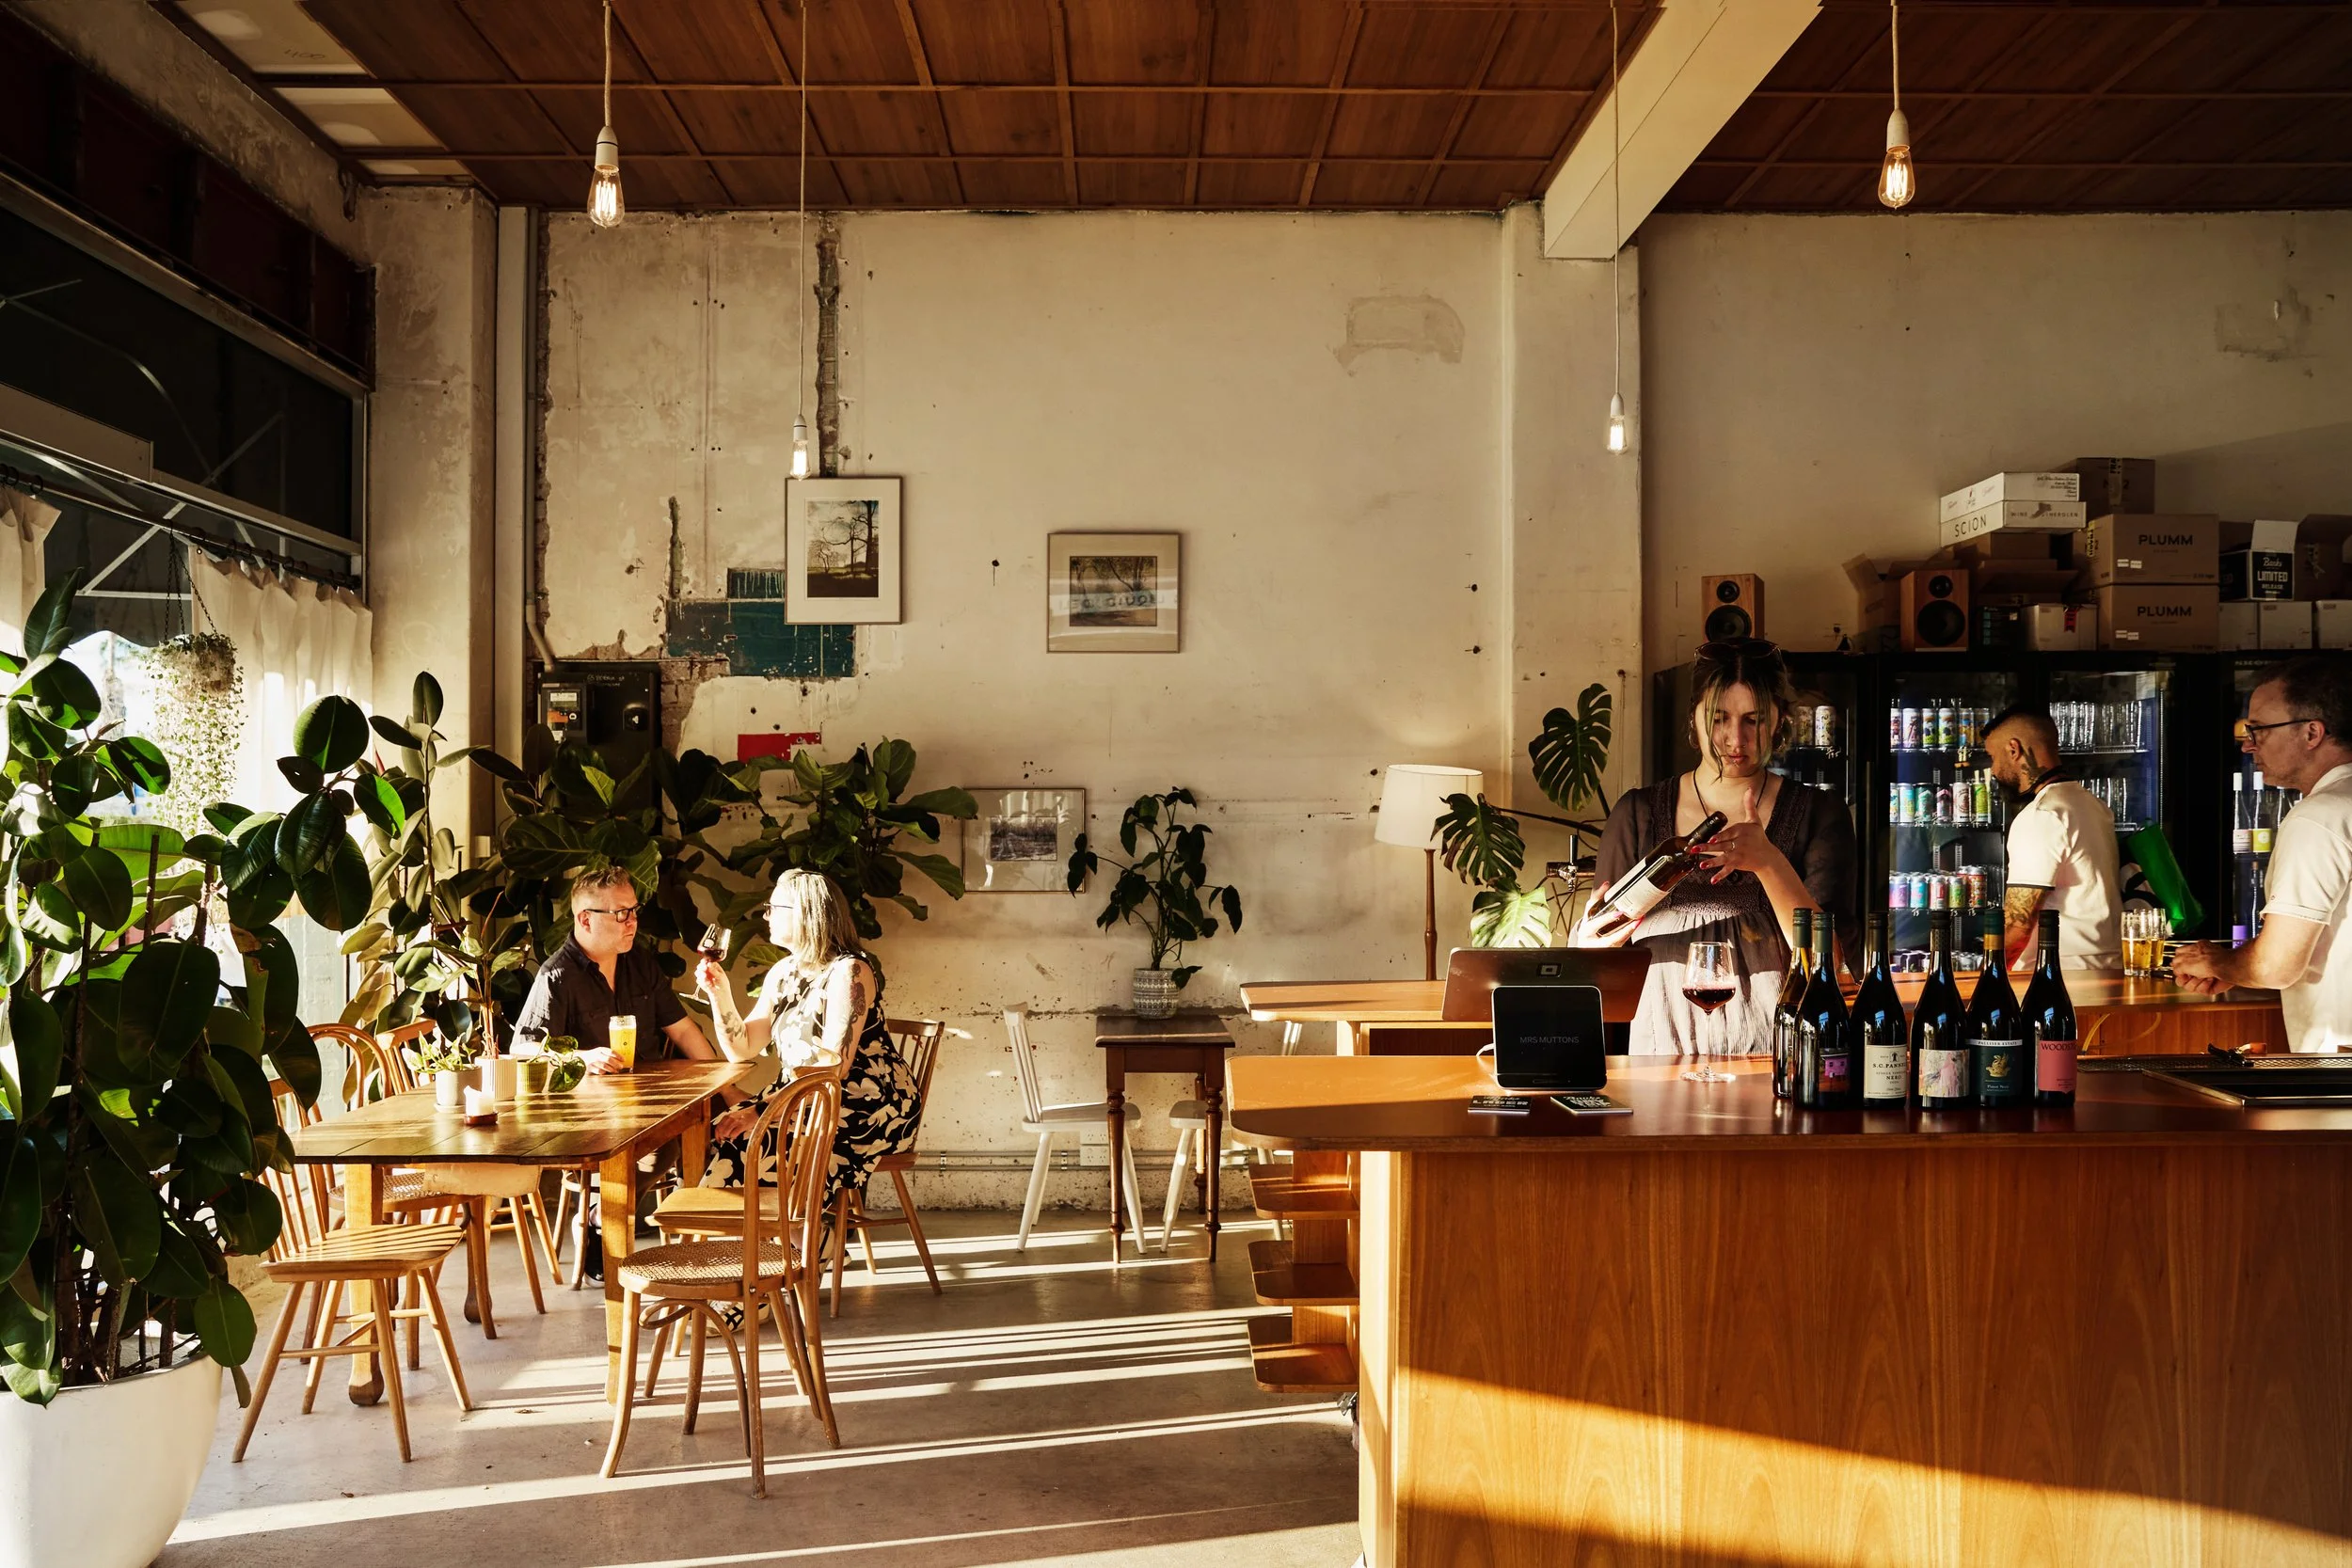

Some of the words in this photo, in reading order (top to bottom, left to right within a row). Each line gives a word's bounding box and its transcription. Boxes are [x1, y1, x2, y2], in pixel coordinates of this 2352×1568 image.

[1954, 514, 1988, 538] SCION
[2138, 534, 2194, 546] PLUMM
[2257, 570, 2289, 582] LIMITED
[2137, 606, 2193, 617] PLUMM
